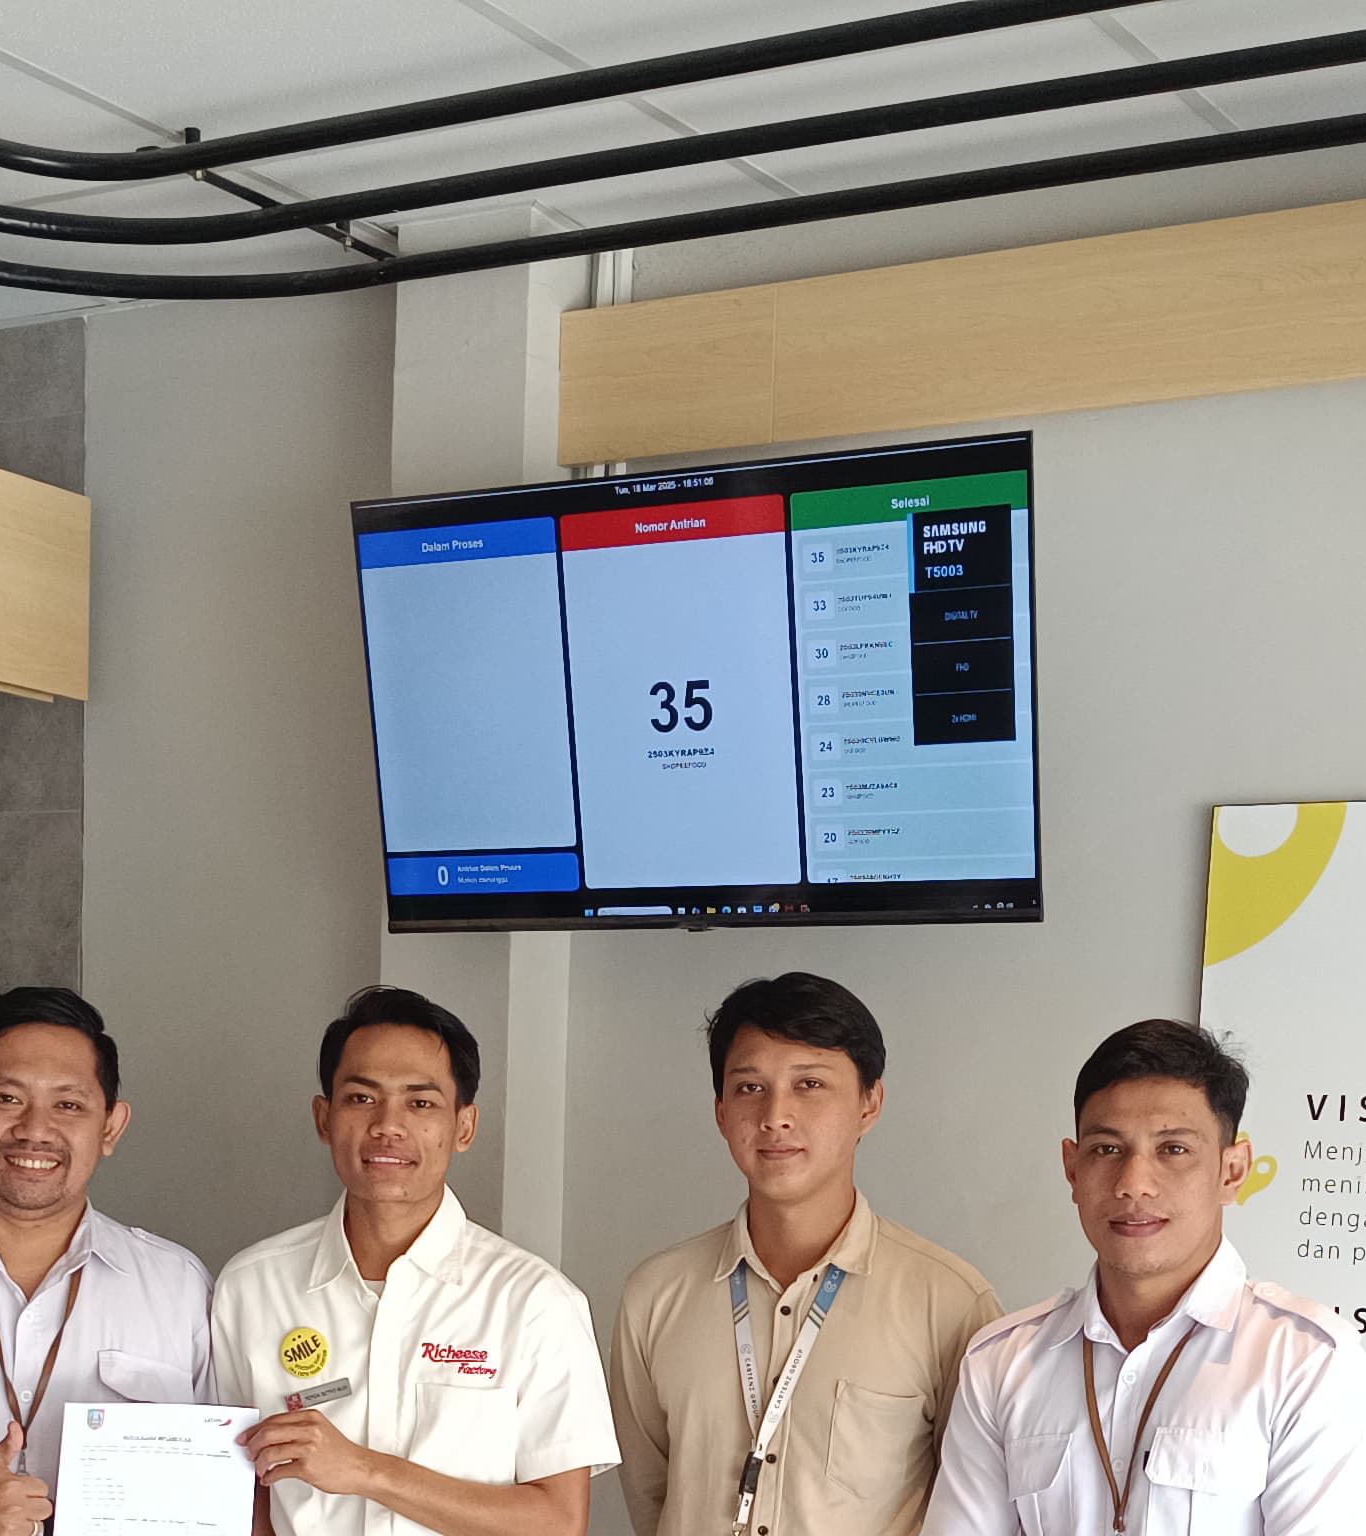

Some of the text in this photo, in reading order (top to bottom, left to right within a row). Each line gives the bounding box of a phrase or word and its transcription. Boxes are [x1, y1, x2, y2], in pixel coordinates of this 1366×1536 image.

[890, 495, 930, 510] Selesai
[635, 517, 707, 535] Nomor Antrian
[923, 520, 987, 538] SAMSUNG
[421, 536, 484, 554] Dalam Proses
[923, 538, 965, 555] FHD TV
[811, 551, 825, 564] 35
[925, 564, 964, 579] T5003
[813, 599, 827, 612] 33
[815, 647, 829, 660] 30
[649, 679, 713, 733] 35
[817, 694, 831, 706] 28
[819, 740, 833, 753] 24
[821, 787, 835, 799] 23
[823, 832, 837, 844] 20
[1298, 1239, 1339, 1259] dan
[284, 1334, 321, 1362] SMILE
[421, 1342, 489, 1363] Richeese
[458, 1363, 497, 1379] Factory
